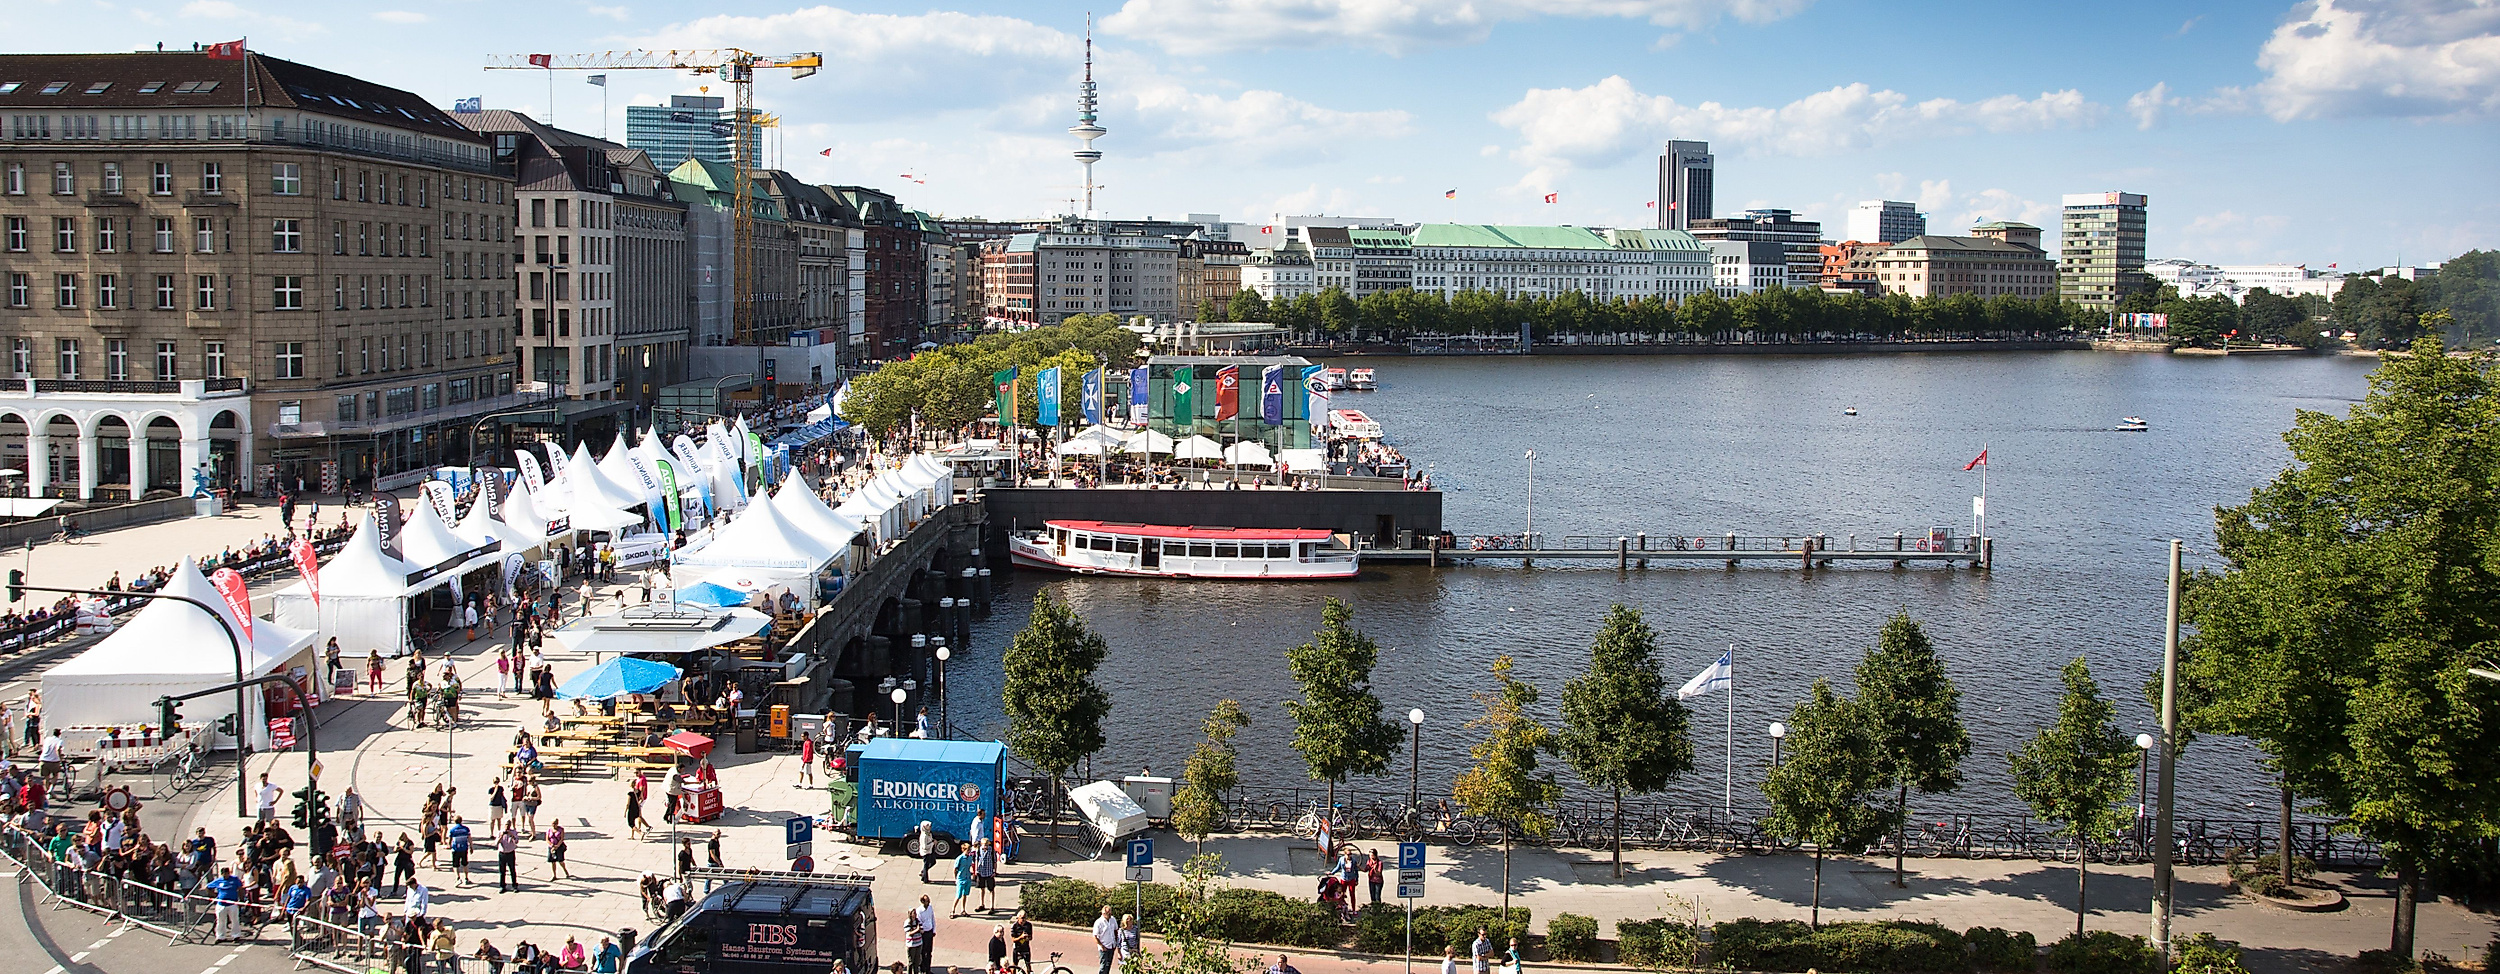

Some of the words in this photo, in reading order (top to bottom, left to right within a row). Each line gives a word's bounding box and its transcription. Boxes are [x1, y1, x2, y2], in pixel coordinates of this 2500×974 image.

[625, 550, 649, 561] ŠKODA
[872, 779, 960, 801] ERDINGER
[872, 800, 980, 813] ALKOHOLFREI
[793, 820, 807, 841] P
[1133, 843, 1148, 863] P
[1403, 846, 1418, 866] P
[747, 923, 798, 946] HBS
